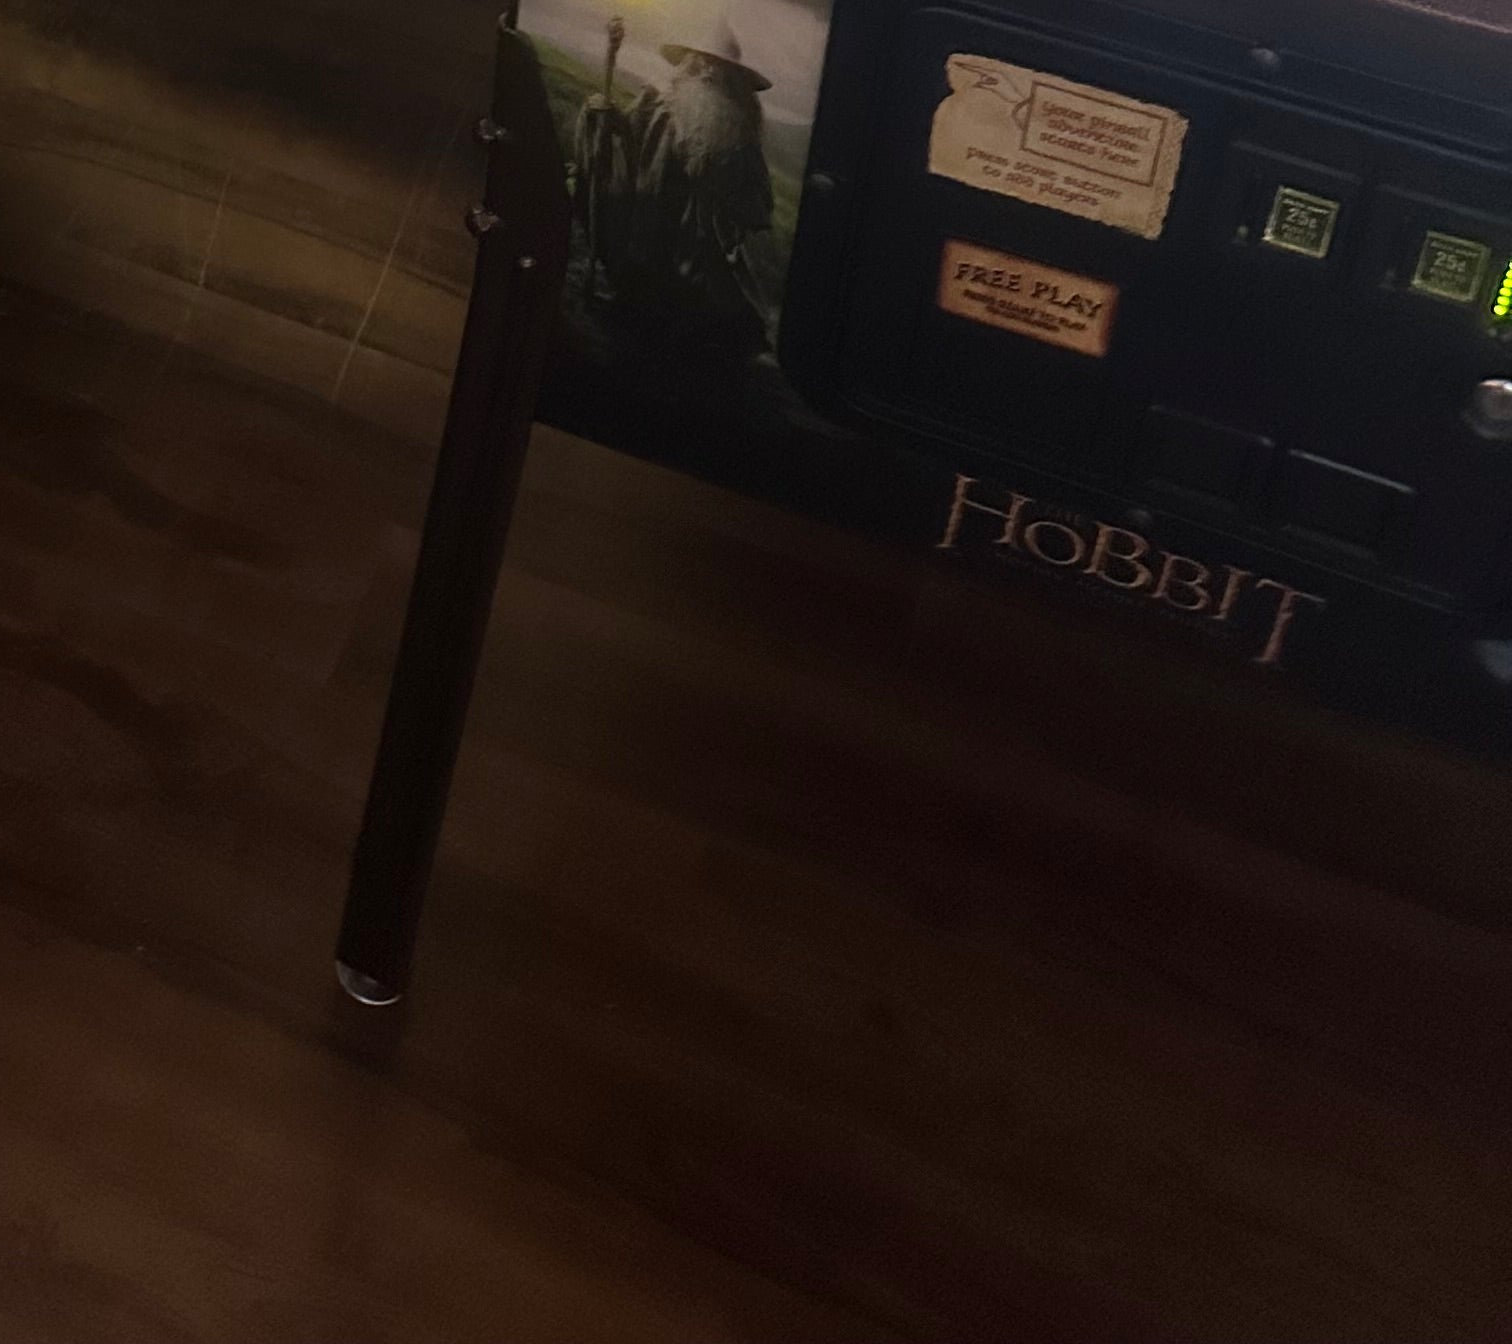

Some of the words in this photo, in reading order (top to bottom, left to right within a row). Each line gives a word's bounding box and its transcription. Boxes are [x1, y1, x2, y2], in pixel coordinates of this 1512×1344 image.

[953, 262, 1022, 293] FREE
[1029, 280, 1104, 319] PLAY
[934, 472, 1328, 666] HOBBIT
